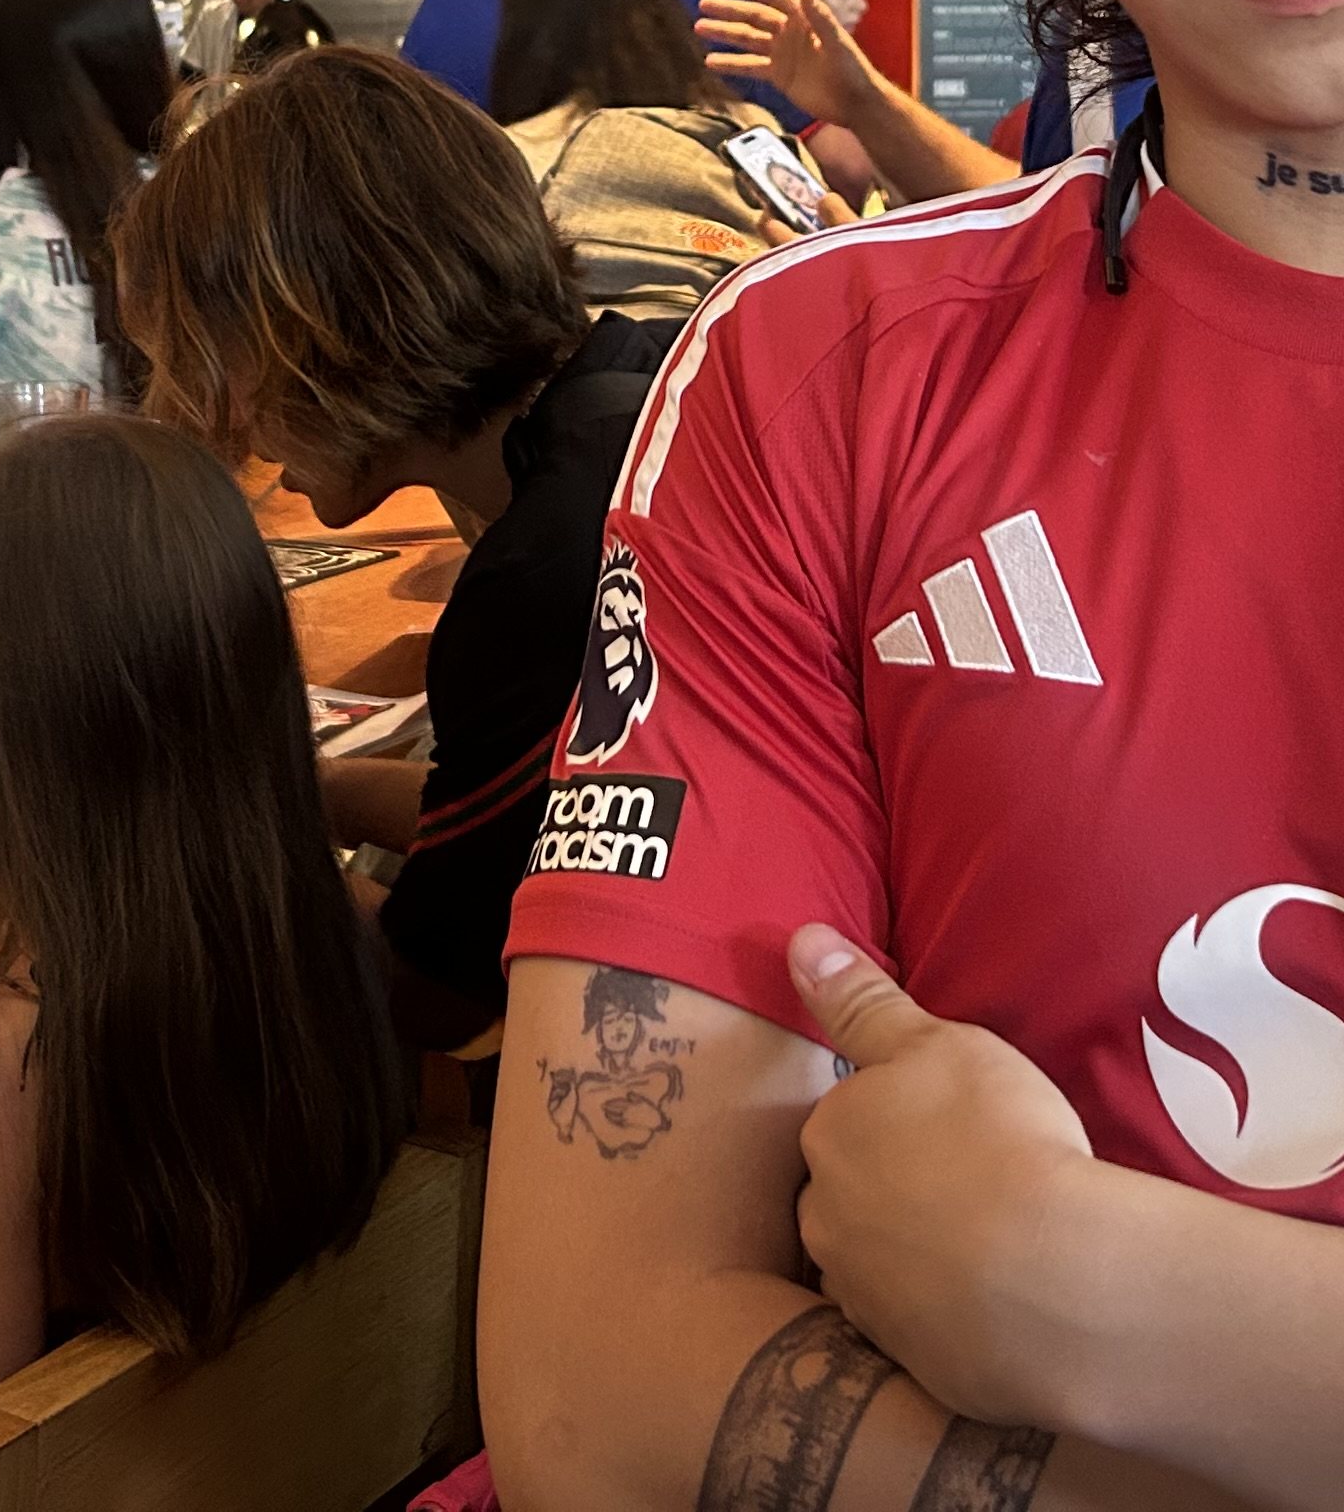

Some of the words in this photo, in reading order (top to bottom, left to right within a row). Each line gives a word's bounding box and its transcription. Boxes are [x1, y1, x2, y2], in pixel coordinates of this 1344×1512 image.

[1256, 151, 1298, 188] je
[541, 783, 655, 833] room
[531, 828, 670, 879] racism
